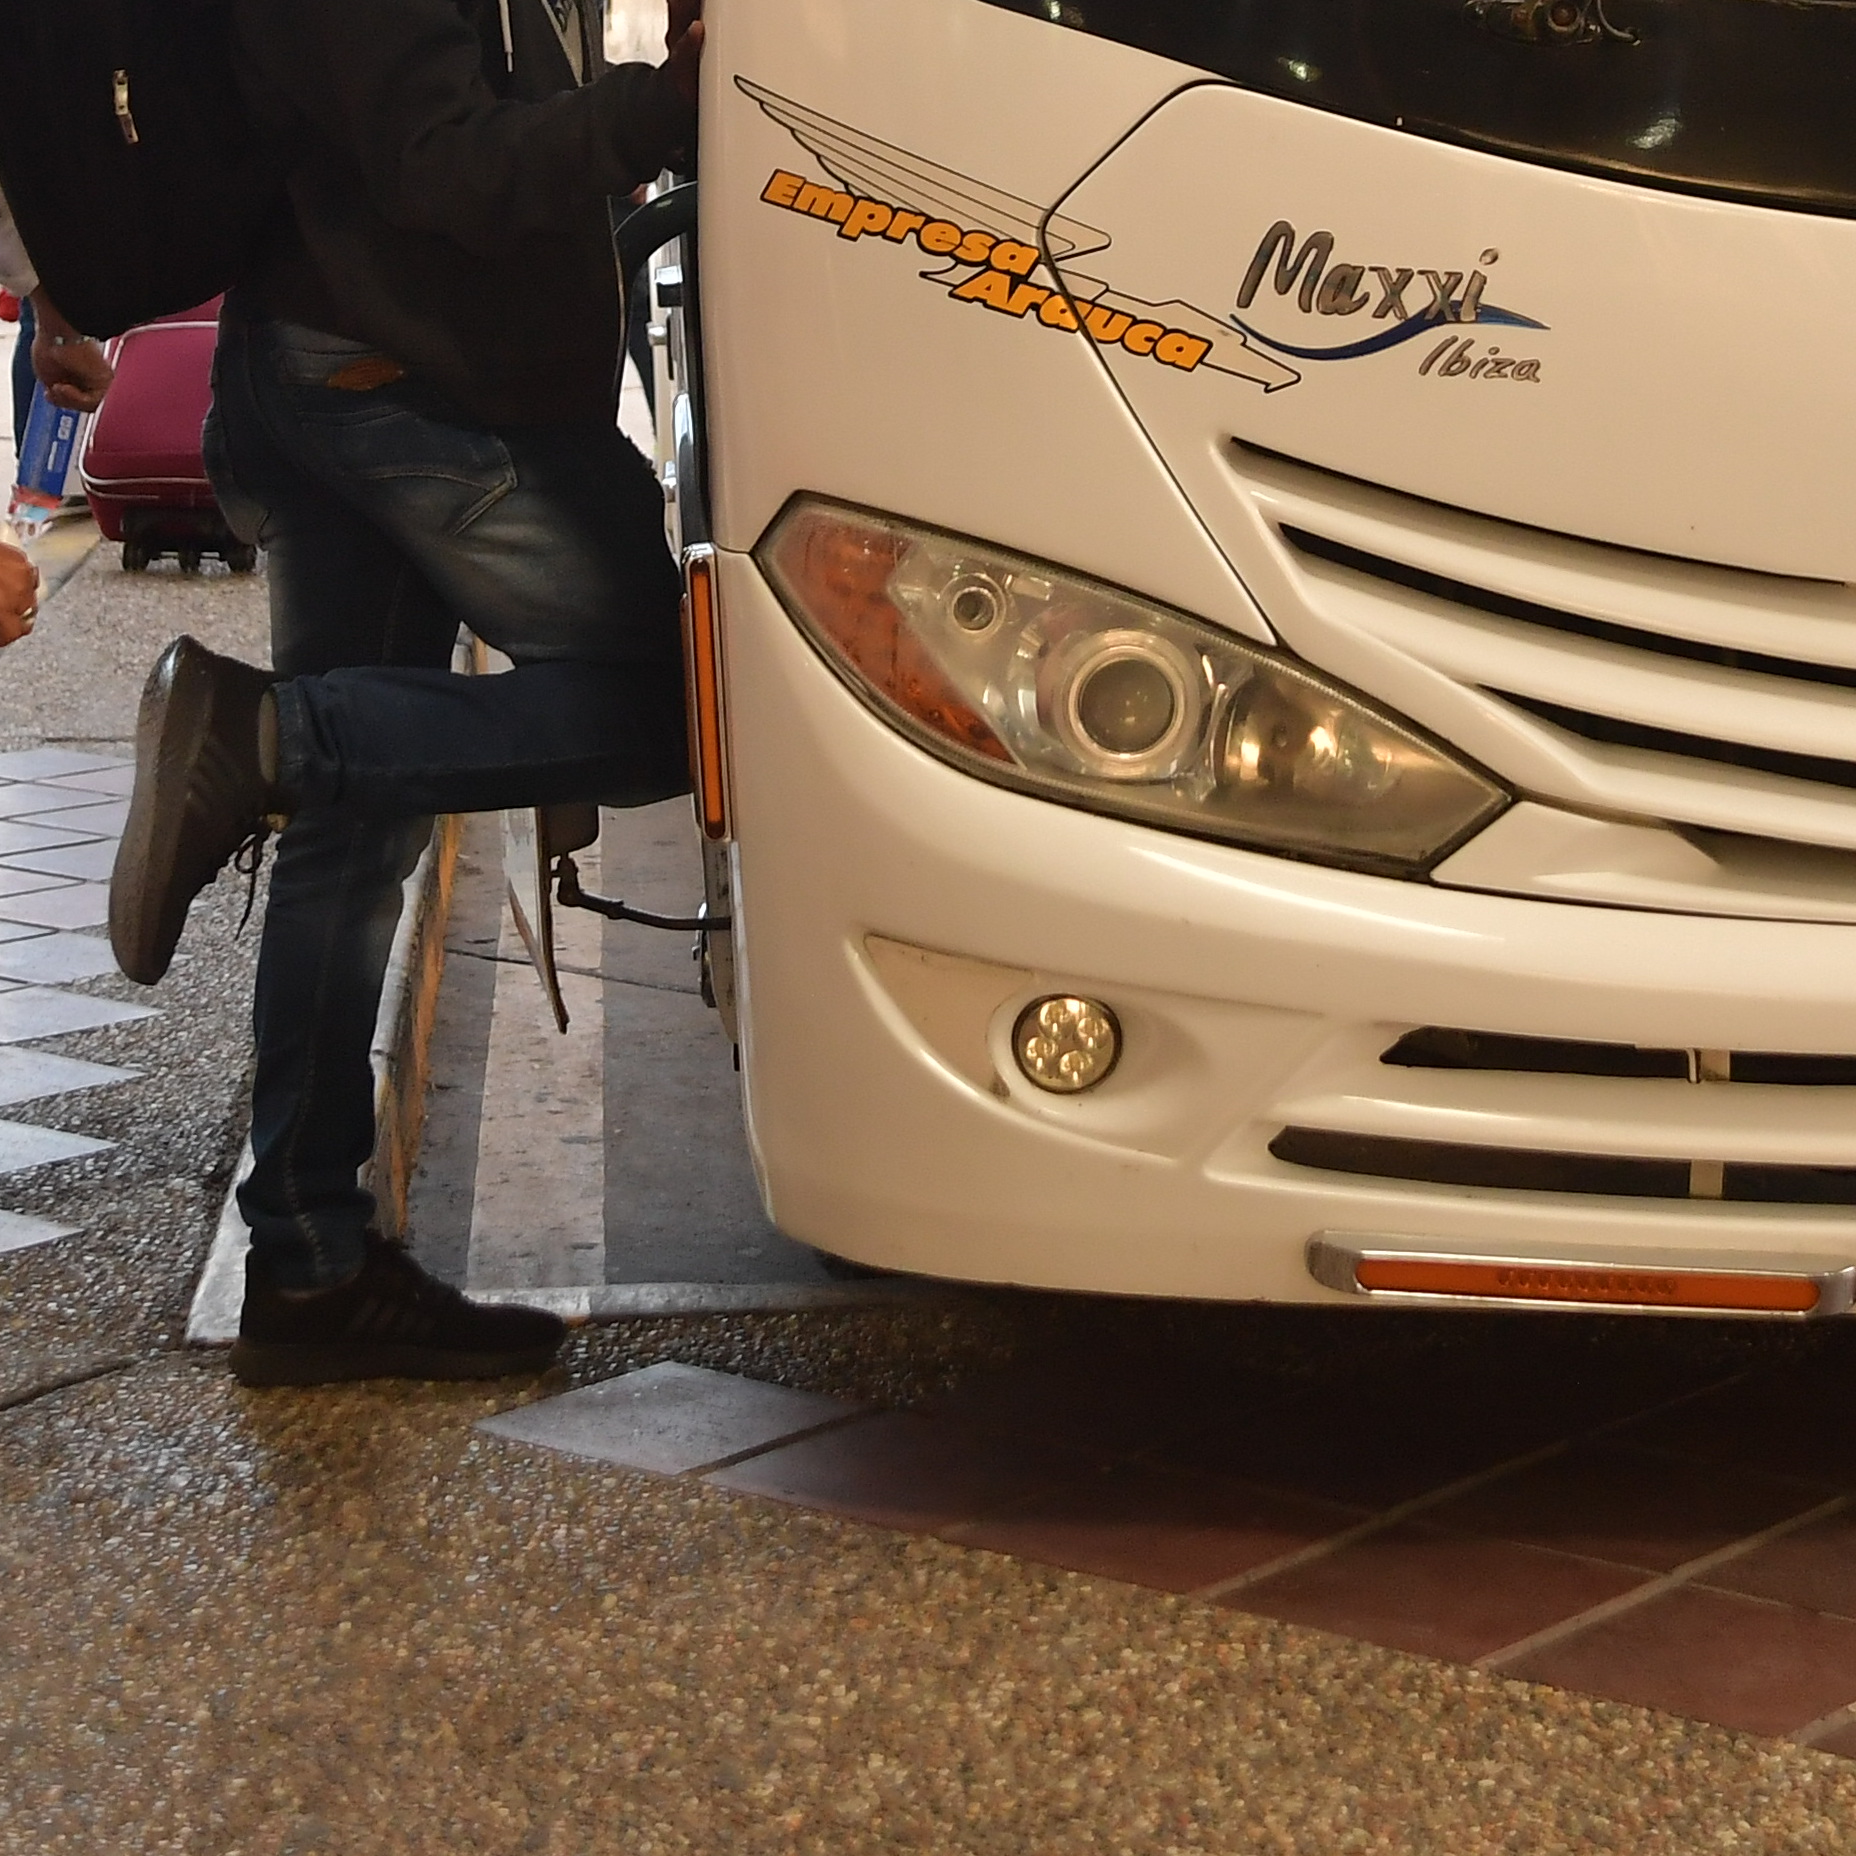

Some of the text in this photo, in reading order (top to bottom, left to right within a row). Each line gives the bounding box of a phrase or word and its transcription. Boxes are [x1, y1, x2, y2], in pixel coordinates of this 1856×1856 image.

[759, 169, 1040, 278] Empresa
[1236, 220, 1499, 324] Maxxi
[948, 263, 1214, 373] Arauca
[1419, 335, 1542, 385] Ibiza
